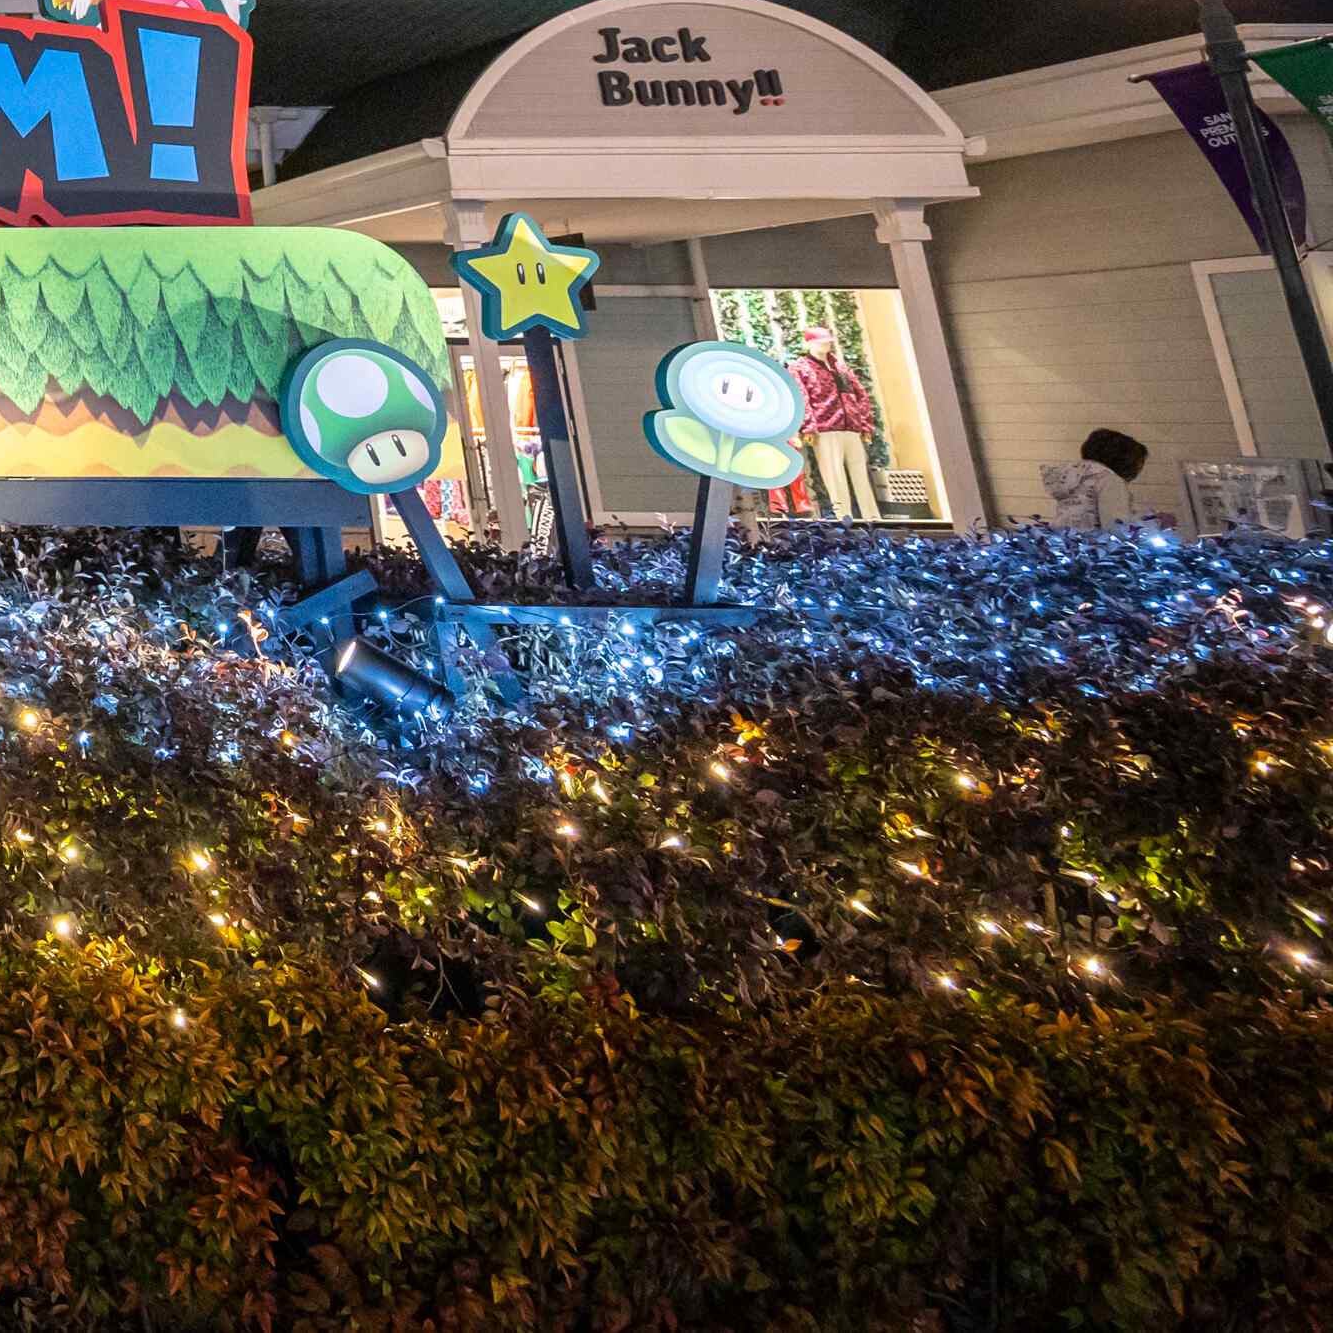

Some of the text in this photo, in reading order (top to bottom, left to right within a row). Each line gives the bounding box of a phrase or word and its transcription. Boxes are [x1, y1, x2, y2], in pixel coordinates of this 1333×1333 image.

[593, 26, 712, 64] Jack
[597, 68, 785, 115] Bunny!!
[1203, 112, 1233, 126] SAN
